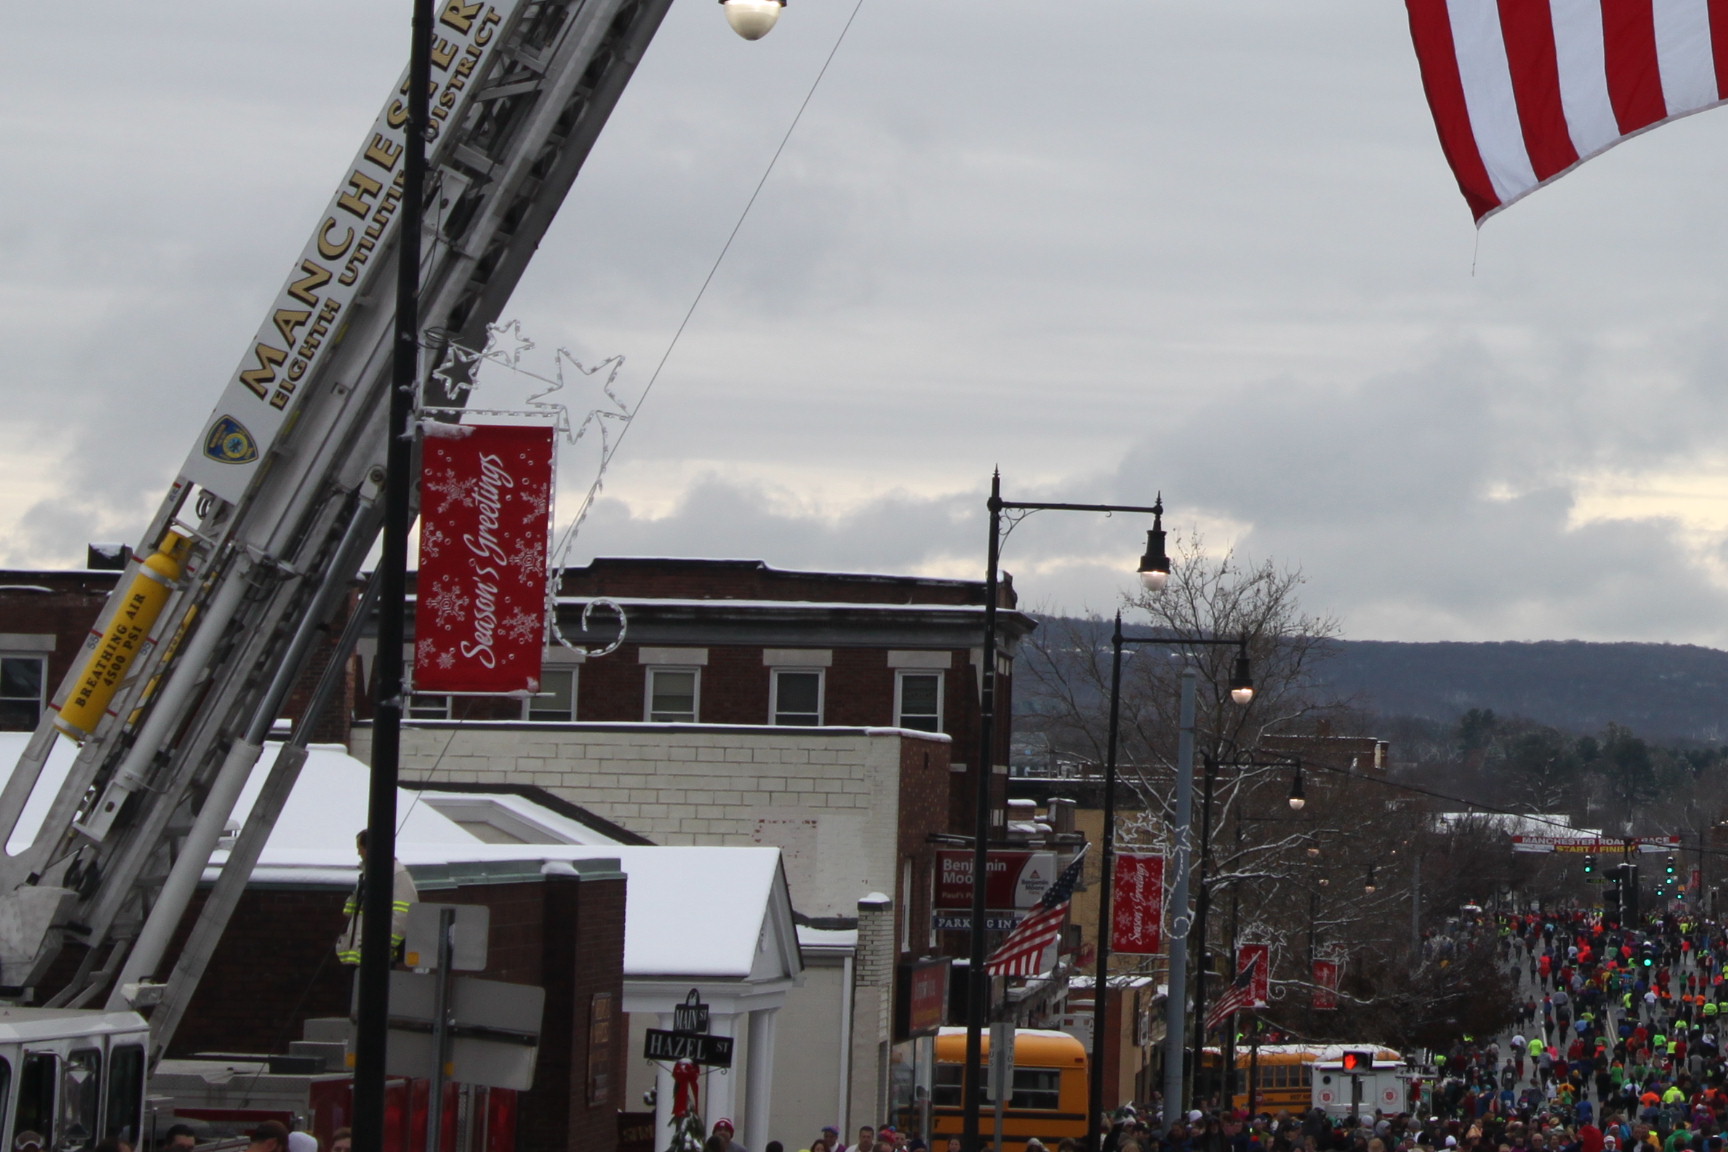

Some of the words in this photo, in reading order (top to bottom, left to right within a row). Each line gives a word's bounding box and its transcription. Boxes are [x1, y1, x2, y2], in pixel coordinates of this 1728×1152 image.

[269, 299, 342, 410] EIGHTH
[338, 167, 408, 287] UTILITIE
[462, 451, 515, 566] Greetings
[460, 565, 500, 669] Season's
[75, 624, 128, 708] BREATHING
[125, 592, 147, 621] AIR
[86, 636, 100, 650] 55
[102, 656, 126, 687] 4500
[123, 625, 143, 654] PSI
[1522, 836, 1595, 846] MANCHESTER
[1599, 836, 1629, 845] ROA
[1557, 845, 1589, 853] START
[943, 858, 1007, 877] Benjmin
[1129, 862, 1149, 904] Greetings
[938, 917, 994, 928] PARKG
[998, 919, 1011, 928] IN
[1129, 902, 1144, 945] Season's
[675, 1009, 698, 1030] MAIN
[700, 1009, 708, 1021] ST
[650, 1033, 706, 1060] HAZEL
[716, 1042, 729, 1054] ST
